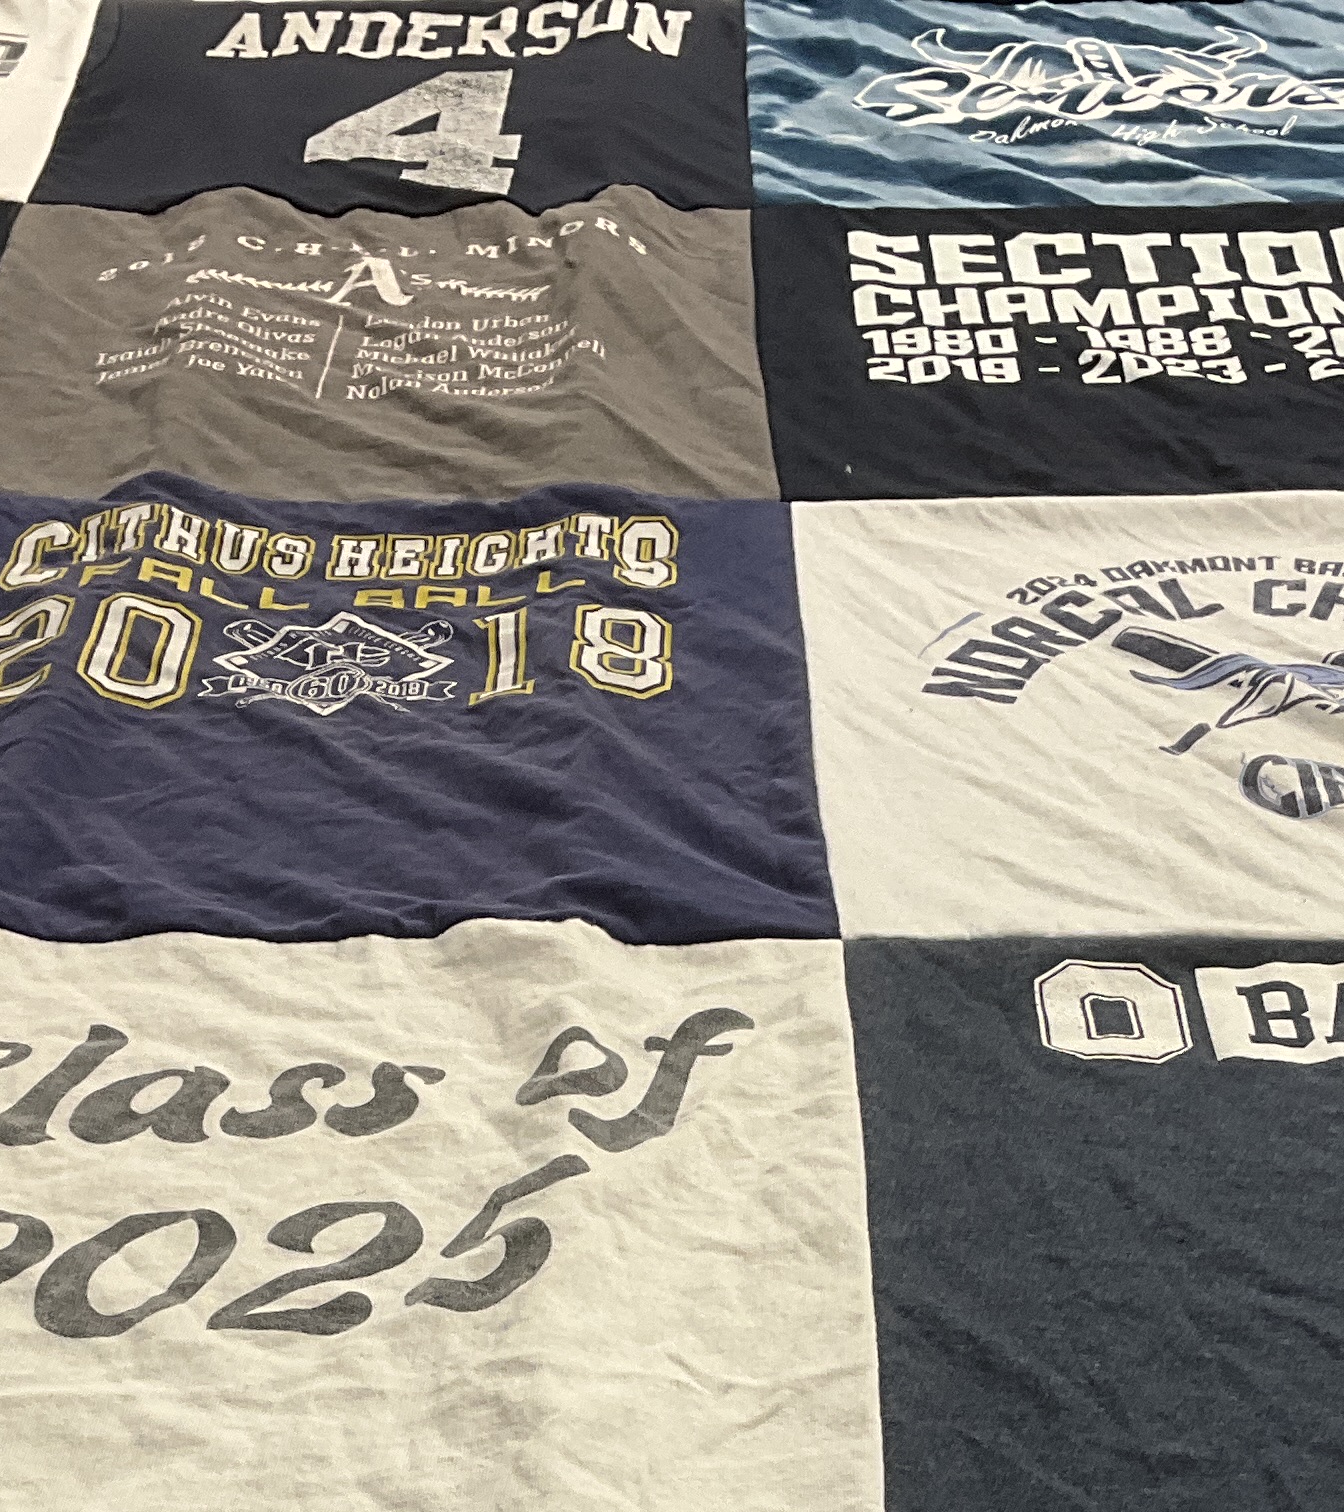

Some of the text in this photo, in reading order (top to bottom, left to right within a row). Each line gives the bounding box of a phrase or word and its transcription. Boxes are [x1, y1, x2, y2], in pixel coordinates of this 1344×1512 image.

[206, 0, 692, 59] ANDERSON
[304, 69, 522, 195] 4
[466, 216, 647, 259] MINORS
[237, 321, 317, 343] Olivas
[241, 306, 322, 327] Evans
[472, 313, 550, 332] Urban
[862, 326, 1019, 357] 1980
[1076, 325, 1234, 357] 1988
[865, 355, 1022, 384] 2019
[1078, 349, 1248, 384] 2023
[325, 512, 679, 588] HEIGHTS
[79, 557, 586, 609] FALL BALL
[1006, 573, 1098, 605] 2024
[468, 604, 674, 704] 18
[921, 577, 1225, 705] NORCAL
[376, 681, 423, 696] 2018
[516, 1007, 755, 1152] of
